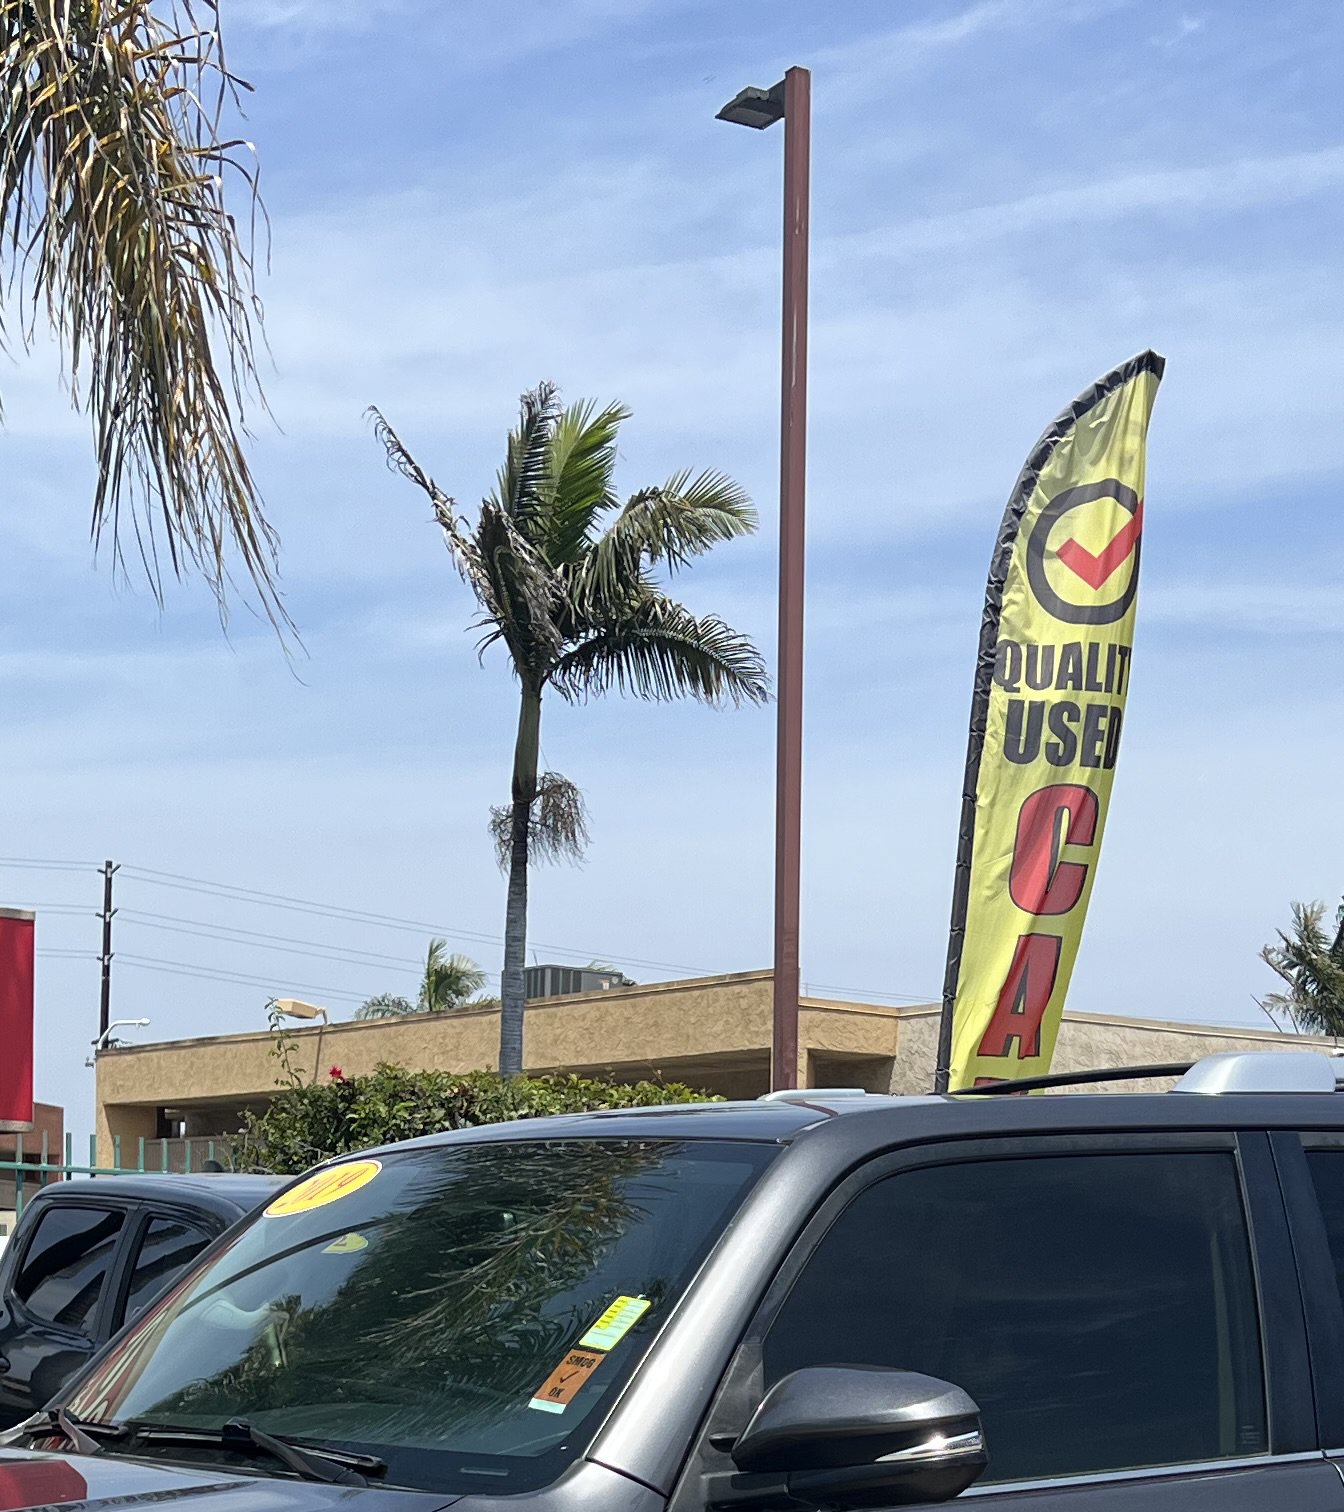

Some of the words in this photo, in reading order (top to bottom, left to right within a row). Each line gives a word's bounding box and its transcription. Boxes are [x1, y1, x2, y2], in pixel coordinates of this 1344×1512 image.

[994, 638, 1133, 694] QUALIT
[1004, 699, 1122, 770] USED
[973, 784, 1099, 1096] CA
[565, 1355, 596, 1369] SMOG
[548, 1386, 565, 1398] OK
